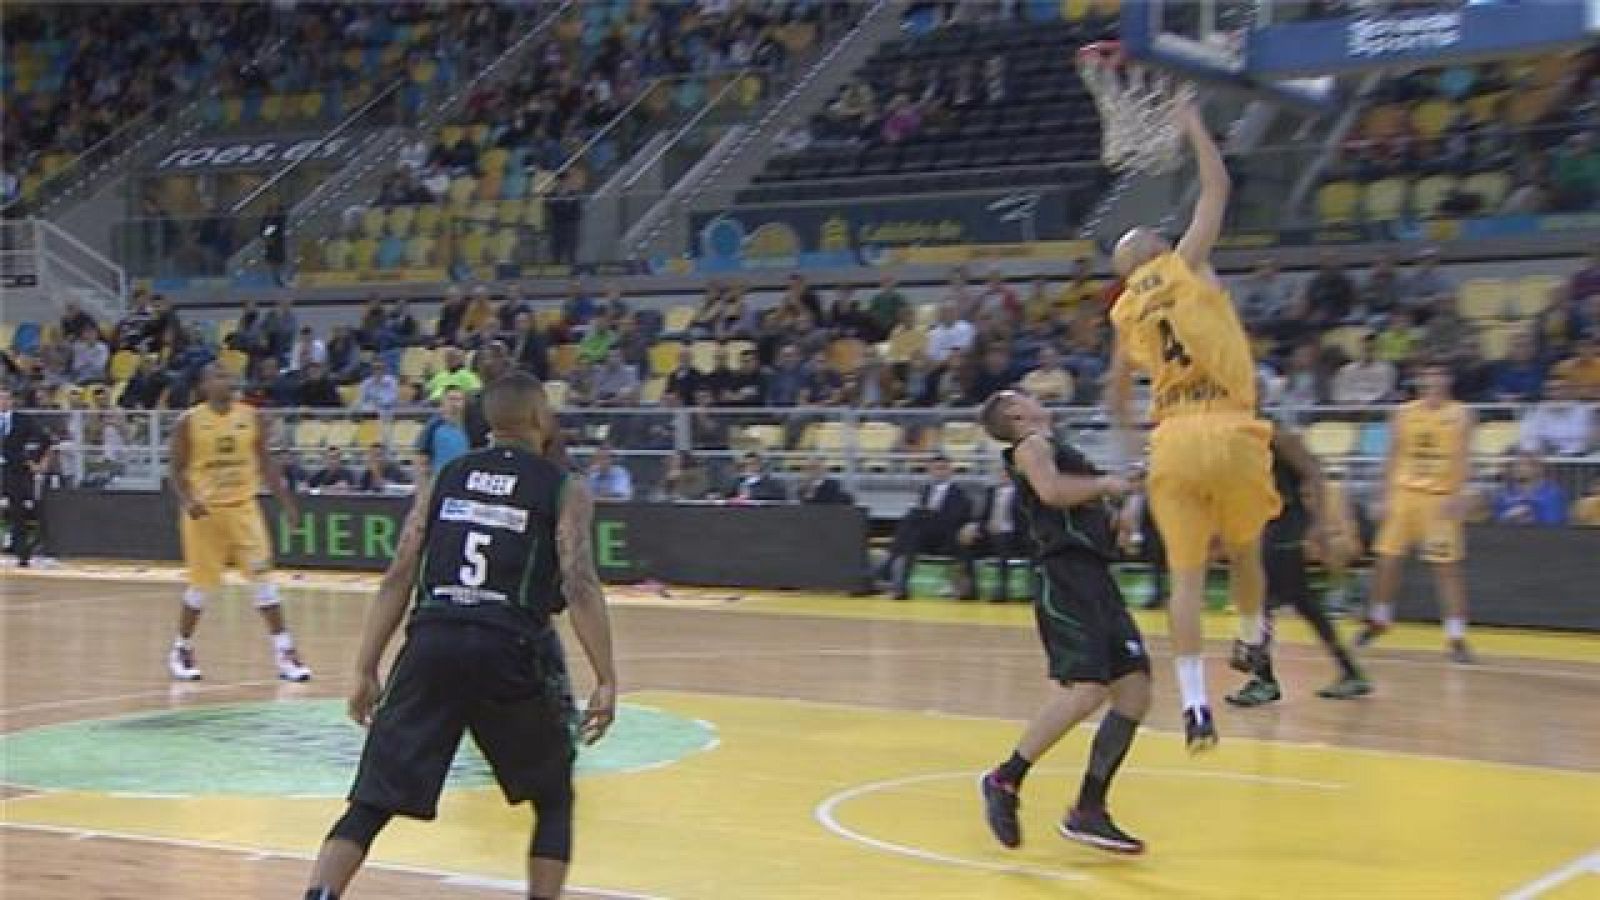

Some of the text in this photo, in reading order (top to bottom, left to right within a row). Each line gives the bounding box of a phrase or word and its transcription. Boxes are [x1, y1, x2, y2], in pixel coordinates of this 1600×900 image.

[1157, 319, 1192, 367] 4
[466, 471, 518, 496] GREEN
[459, 531, 491, 586] 5
